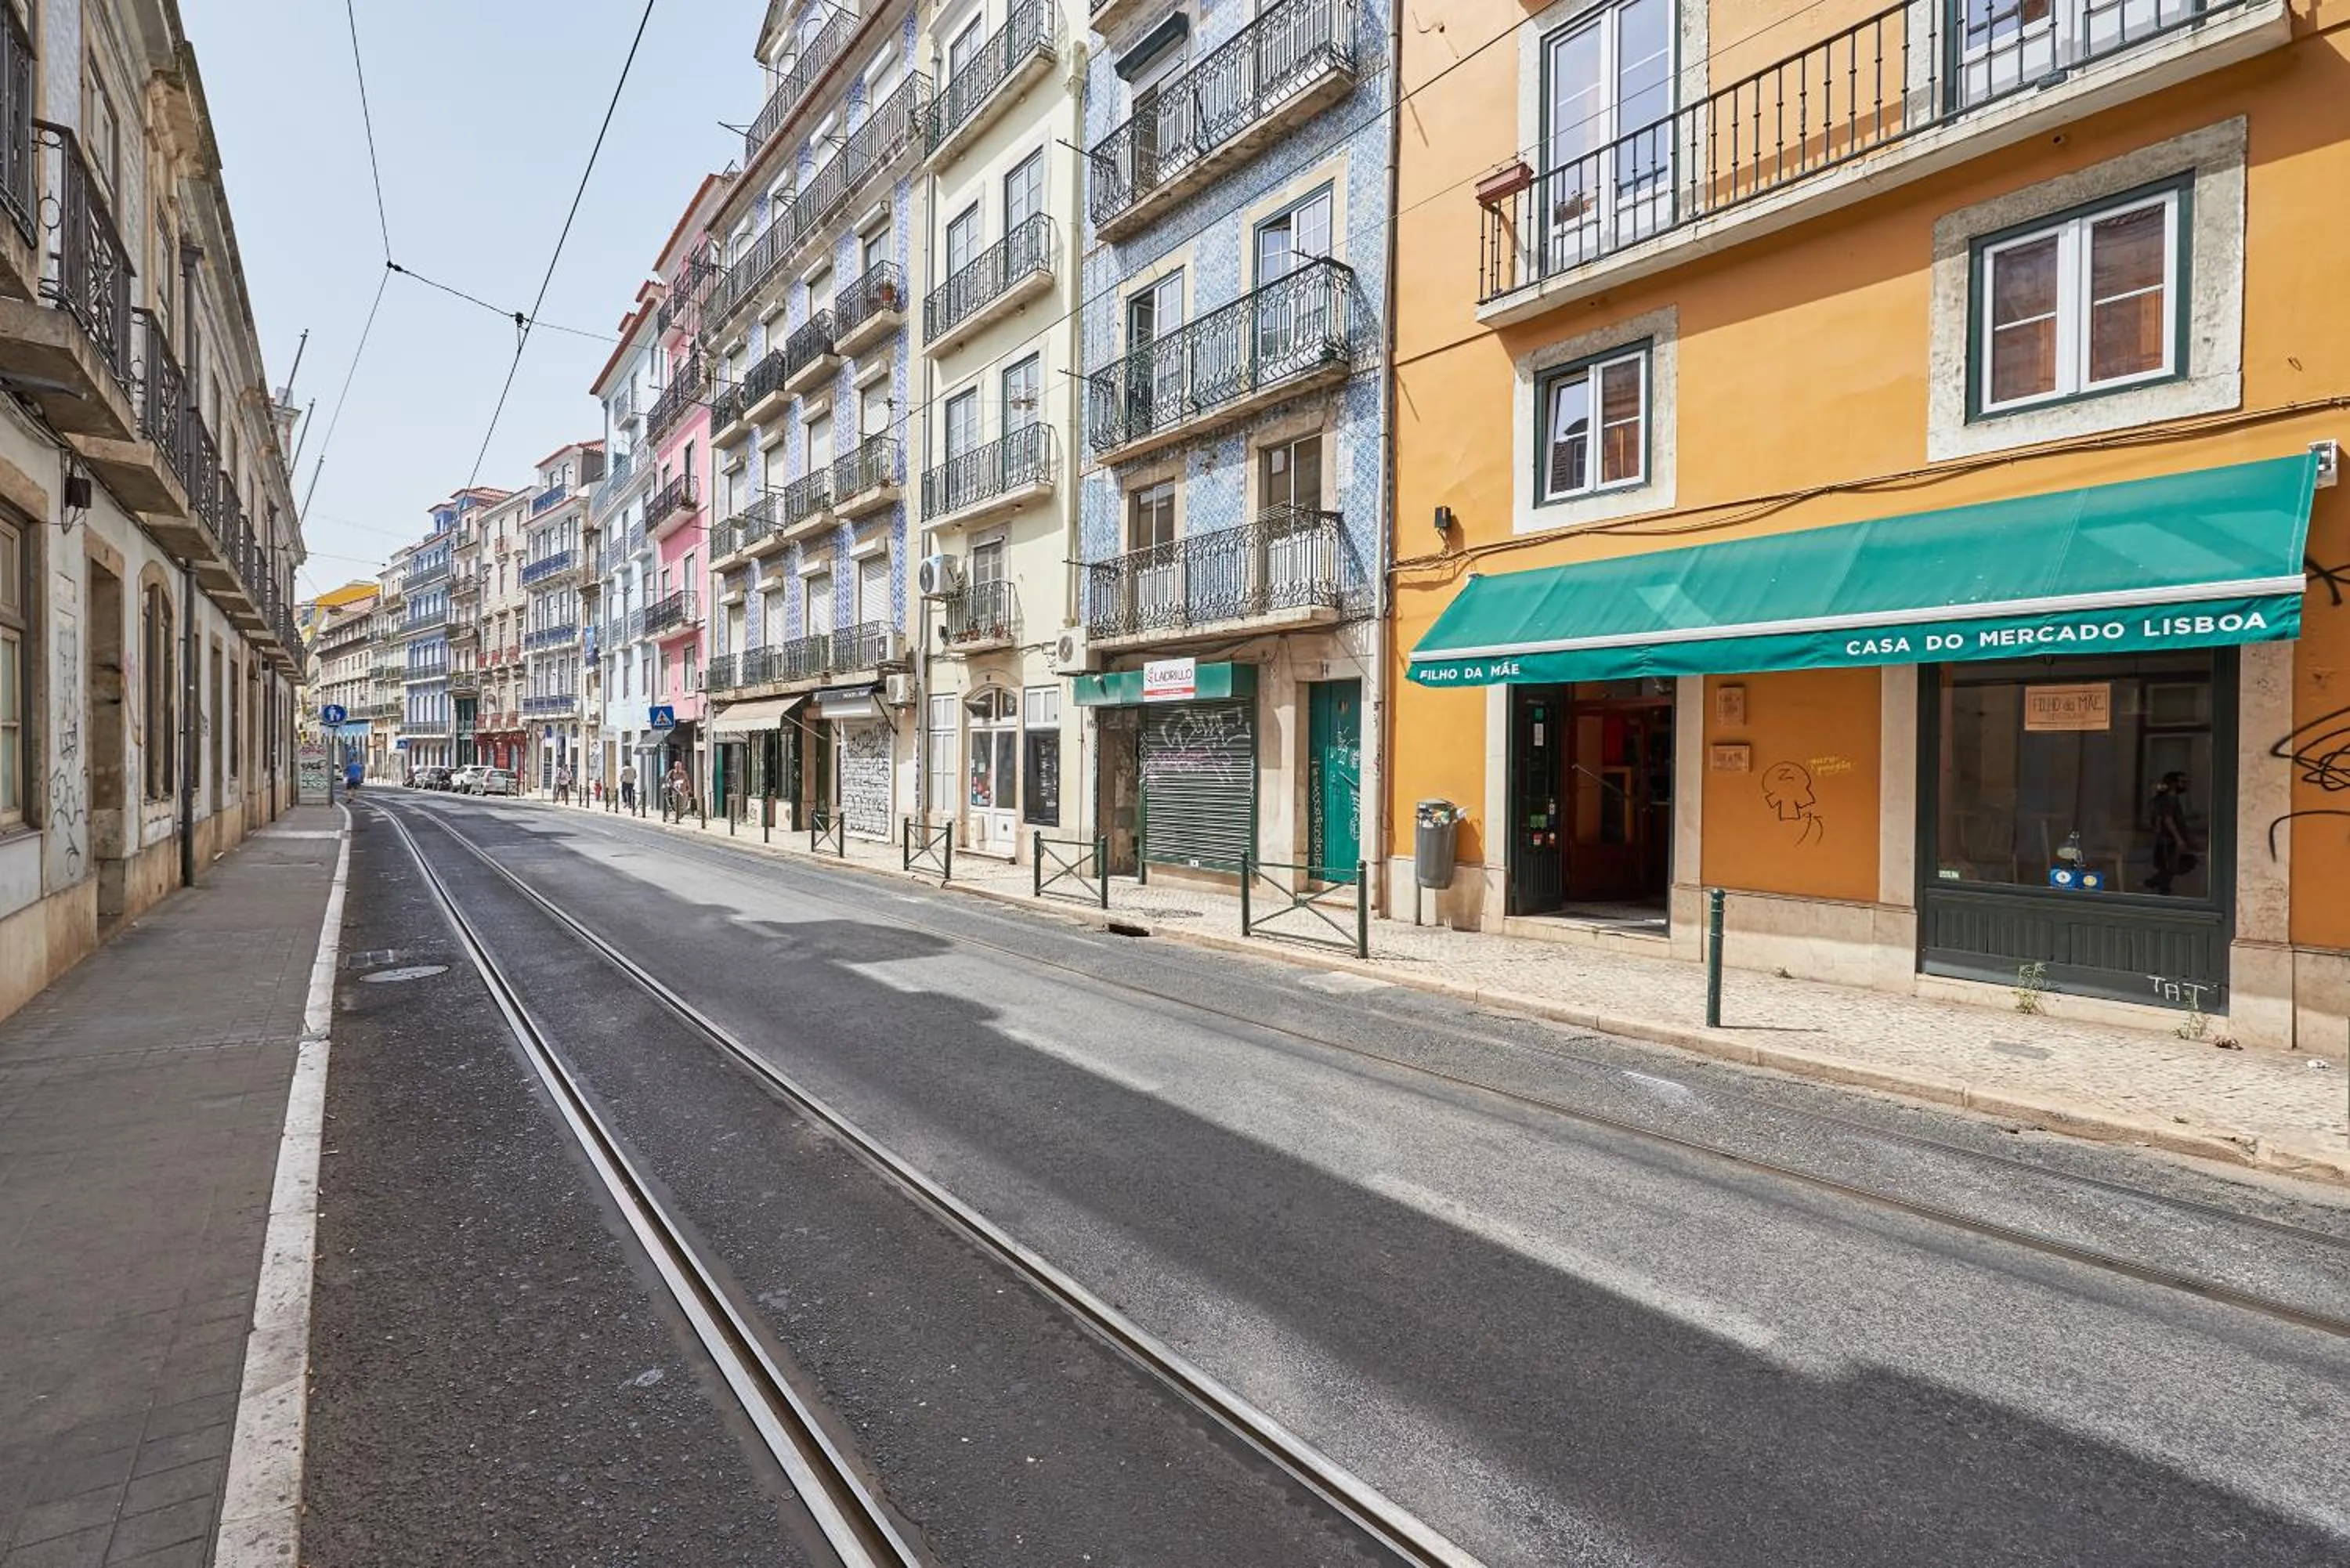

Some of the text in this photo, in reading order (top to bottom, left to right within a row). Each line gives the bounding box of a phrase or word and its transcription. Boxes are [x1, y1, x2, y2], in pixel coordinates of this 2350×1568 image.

[1846, 612, 2268, 656] CASA DO MERCADO LISBOA
[1419, 661, 1520, 681] FILHO DA MÃE
